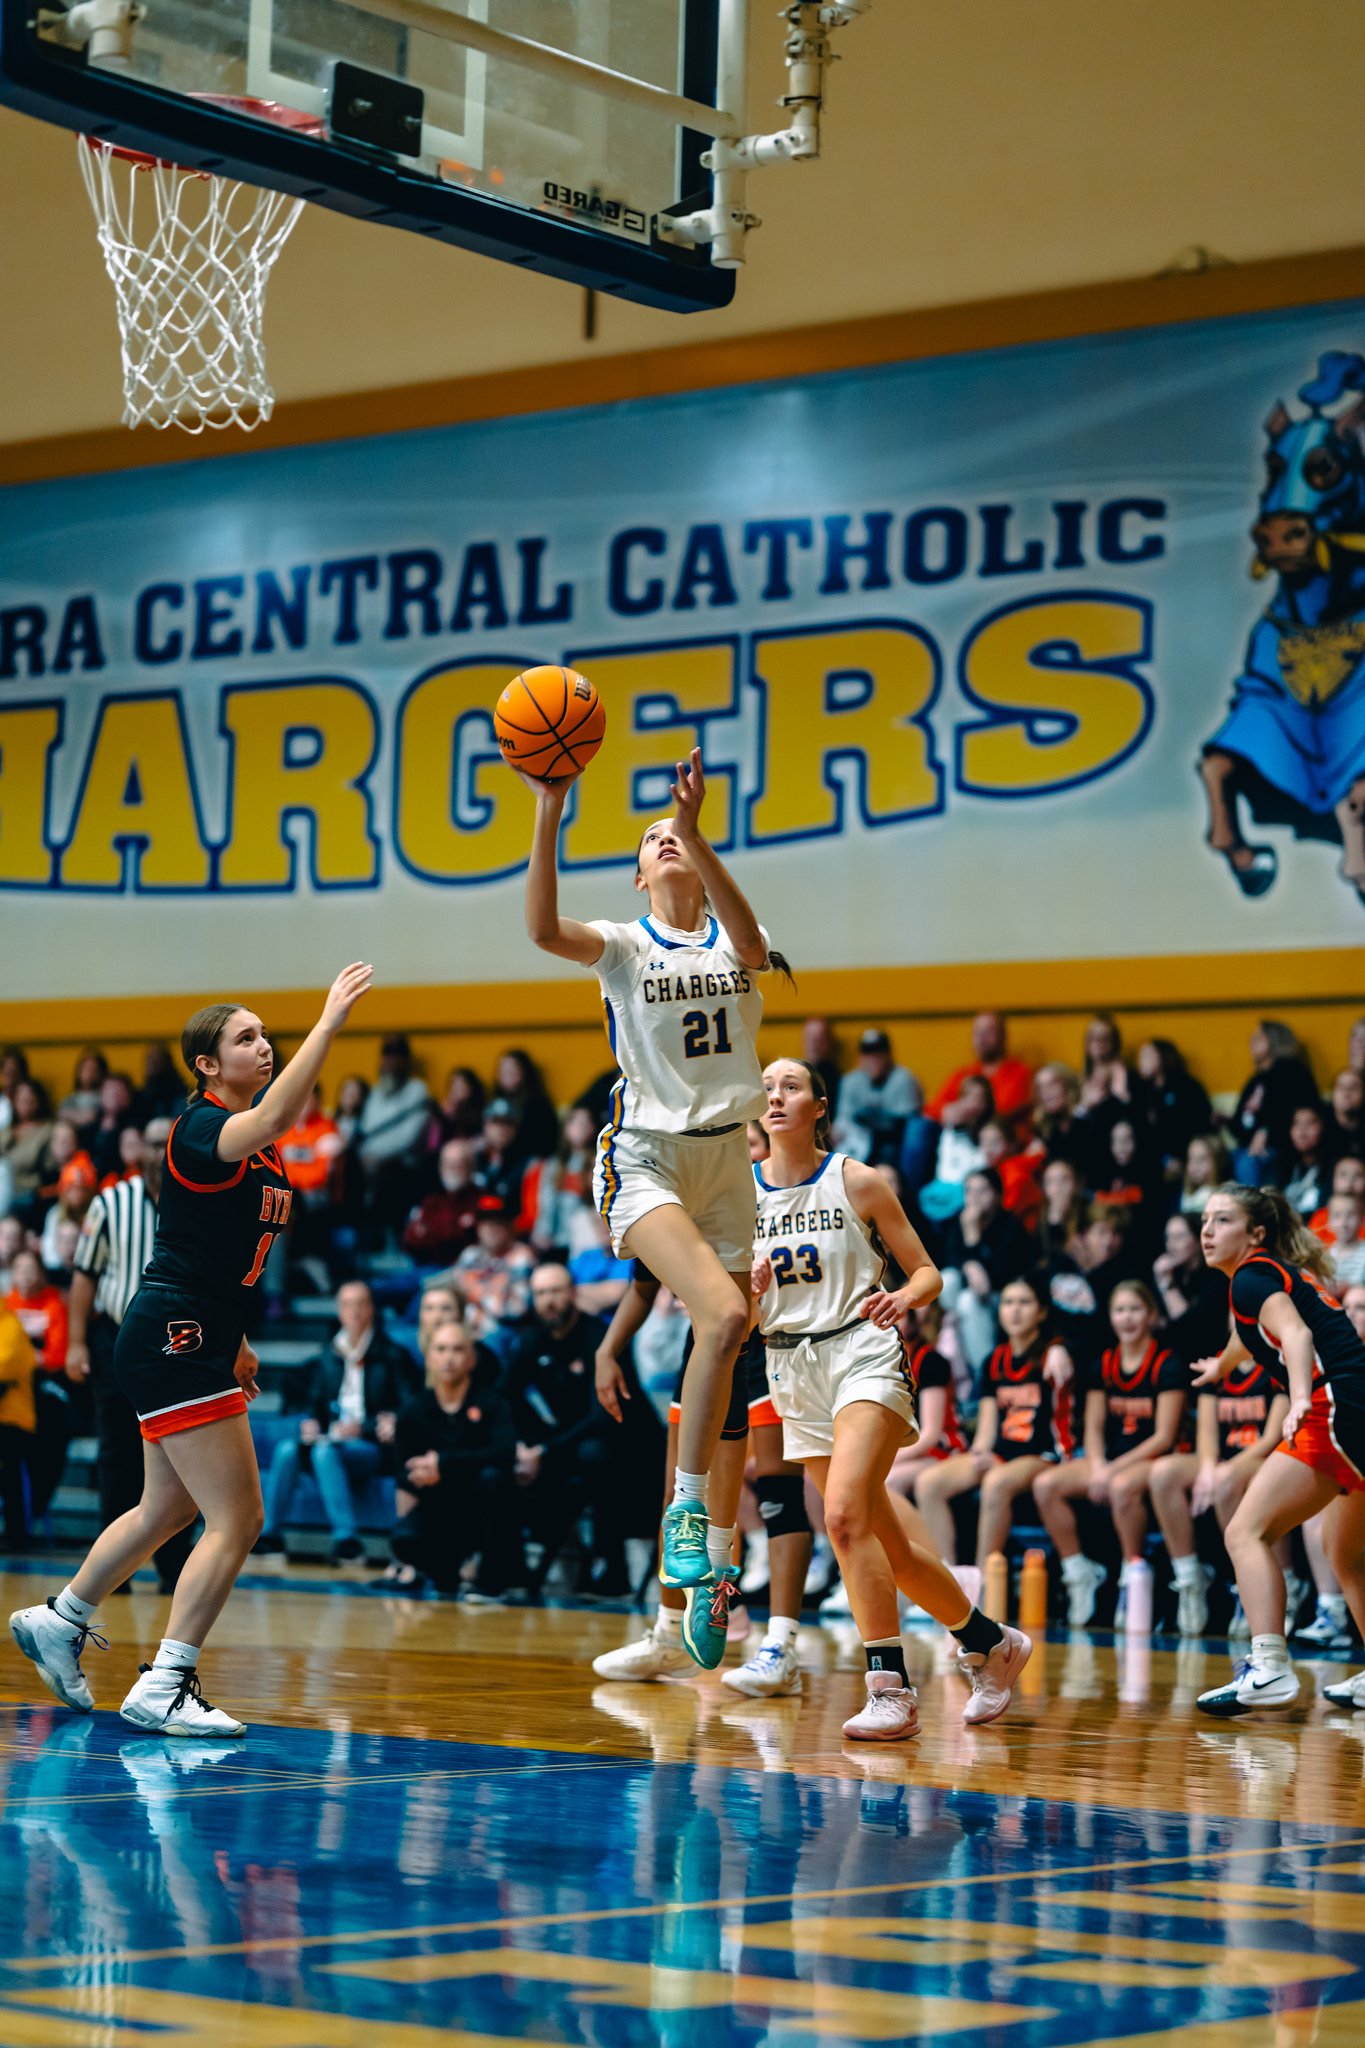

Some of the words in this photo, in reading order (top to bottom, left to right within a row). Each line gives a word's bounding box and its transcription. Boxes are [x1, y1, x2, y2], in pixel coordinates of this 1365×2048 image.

[134, 536, 574, 664] CENTRAL
[608, 499, 1166, 617] CATHOLIC
[643, 970, 751, 1004] CHARGERS
[682, 1006, 732, 1059] 21
[752, 1208, 844, 1240] HARGERS
[770, 1243, 823, 1289] 23
